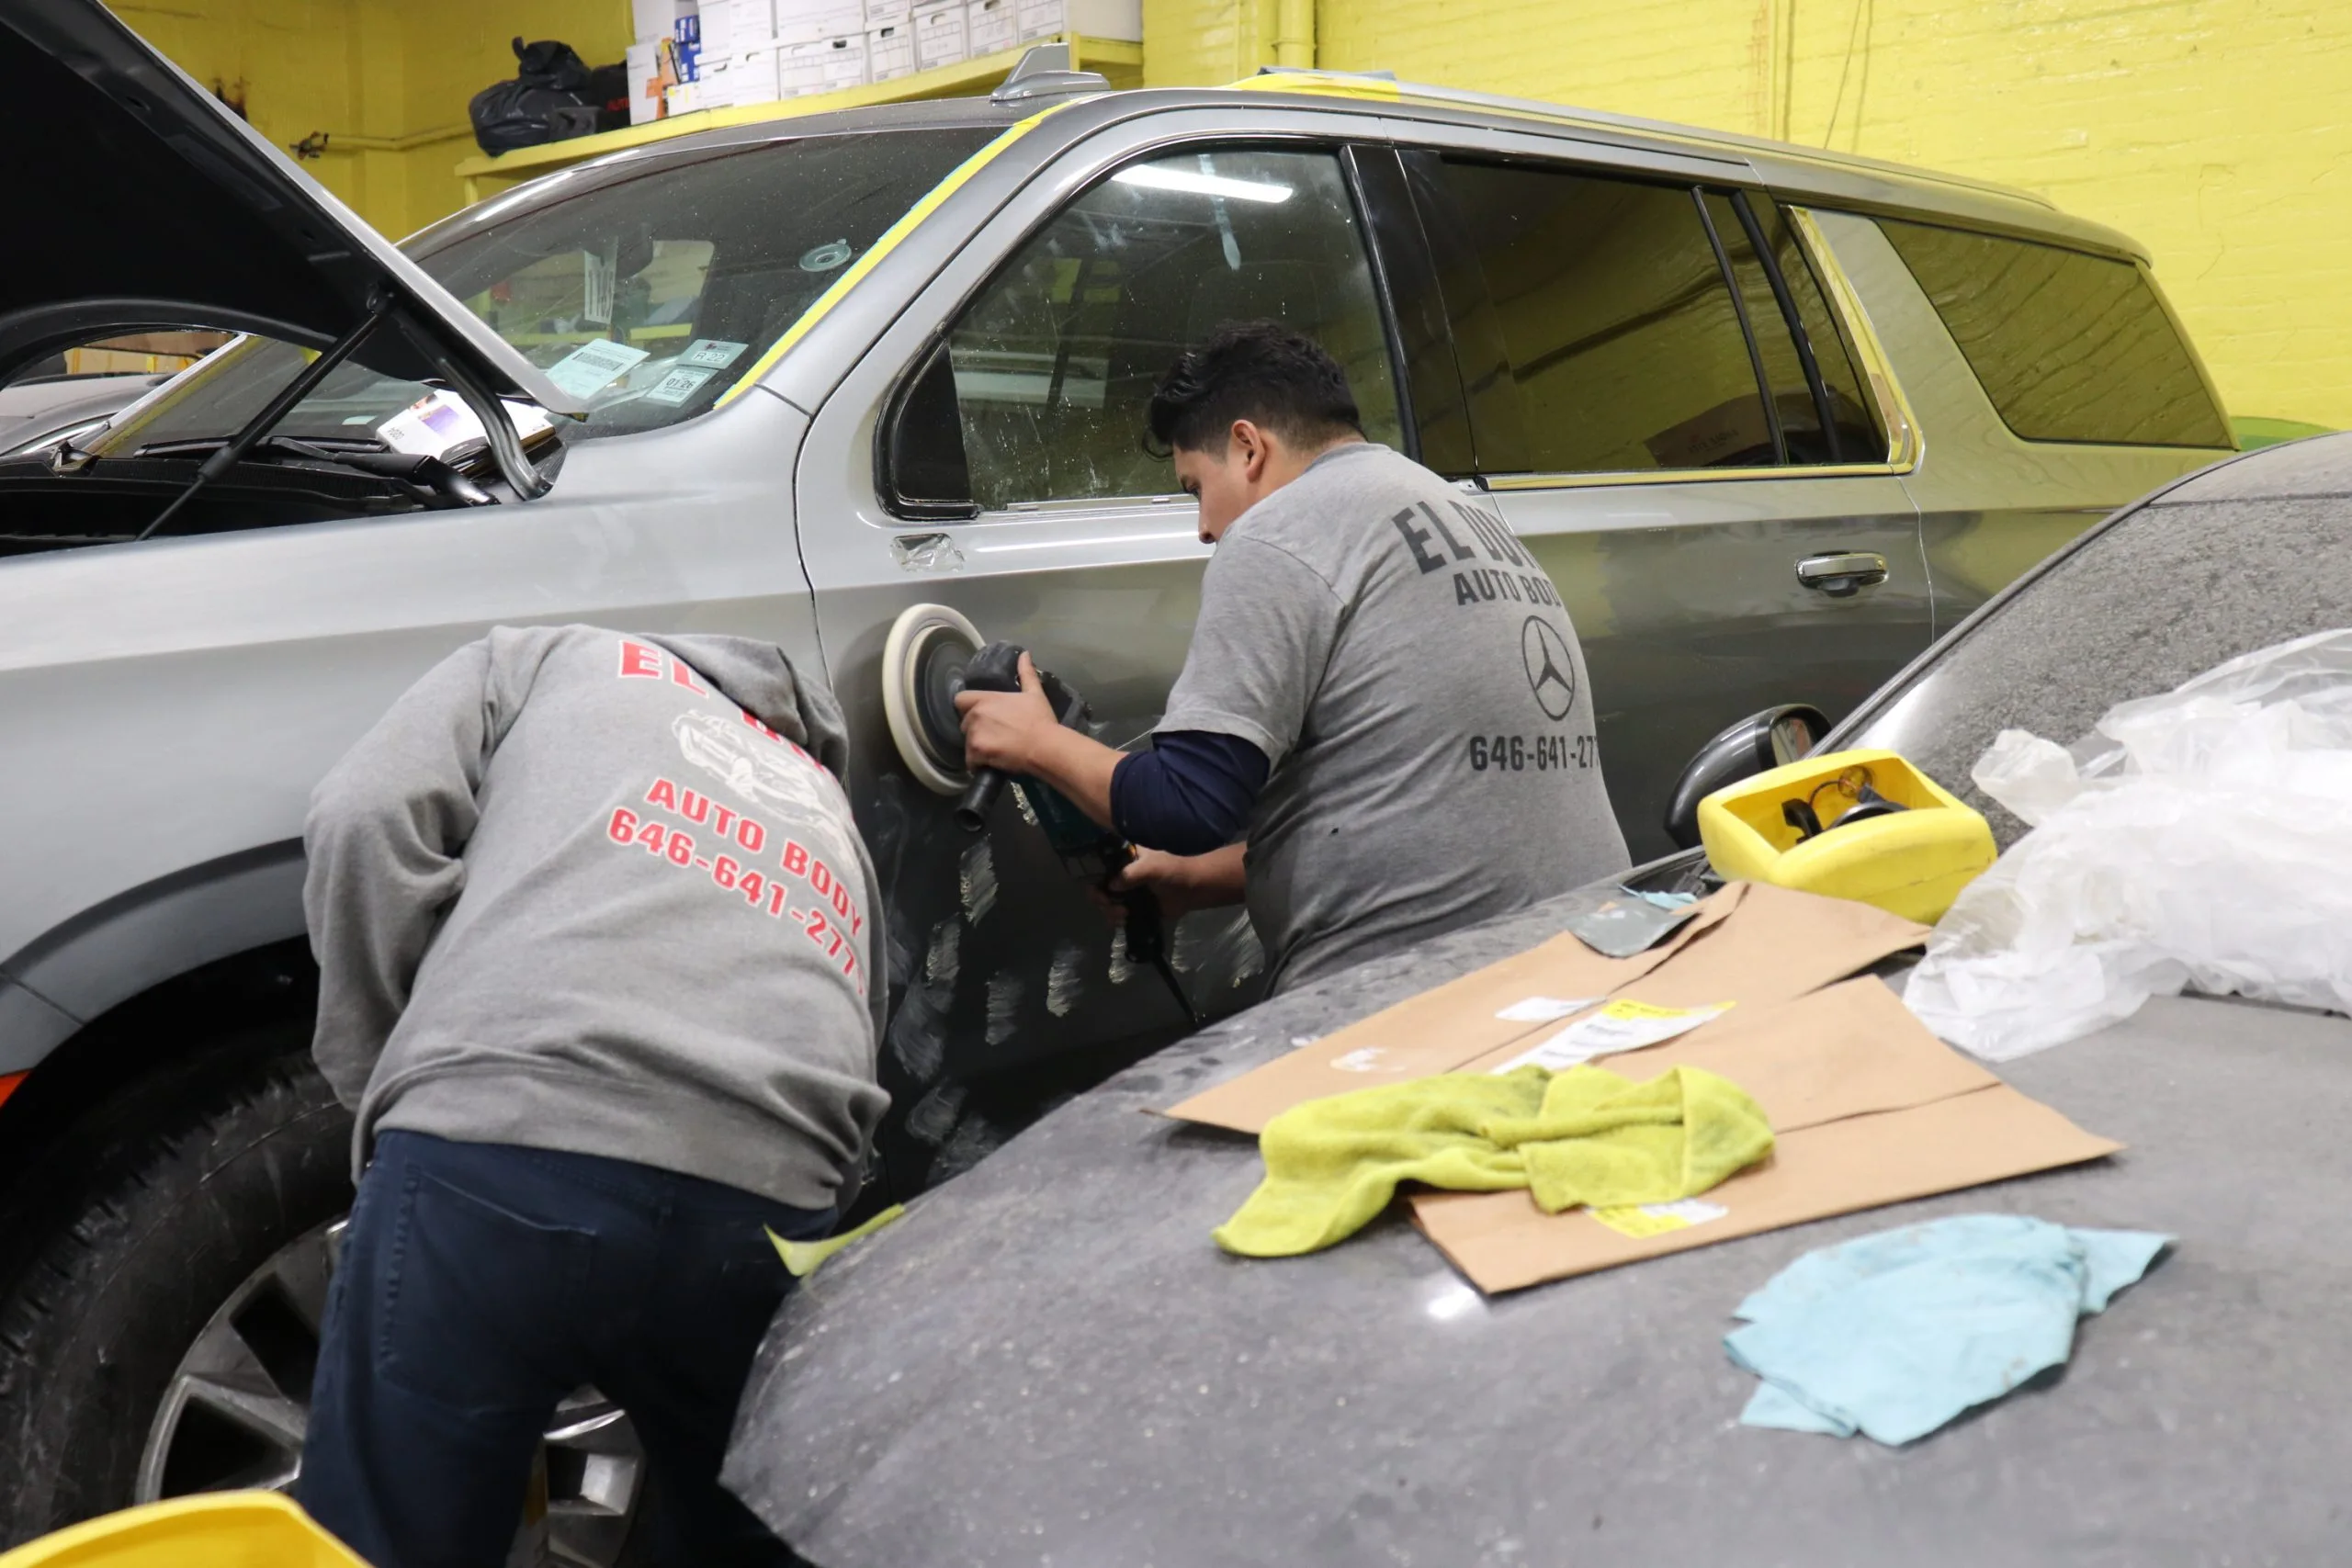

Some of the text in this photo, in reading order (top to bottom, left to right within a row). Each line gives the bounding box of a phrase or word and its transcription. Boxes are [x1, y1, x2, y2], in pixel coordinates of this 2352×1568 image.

[1392, 501, 1476, 575] EL
[1453, 569, 1522, 606] AUTO
[618, 639, 709, 698] EL
[646, 778, 863, 937] AUTO BODY
